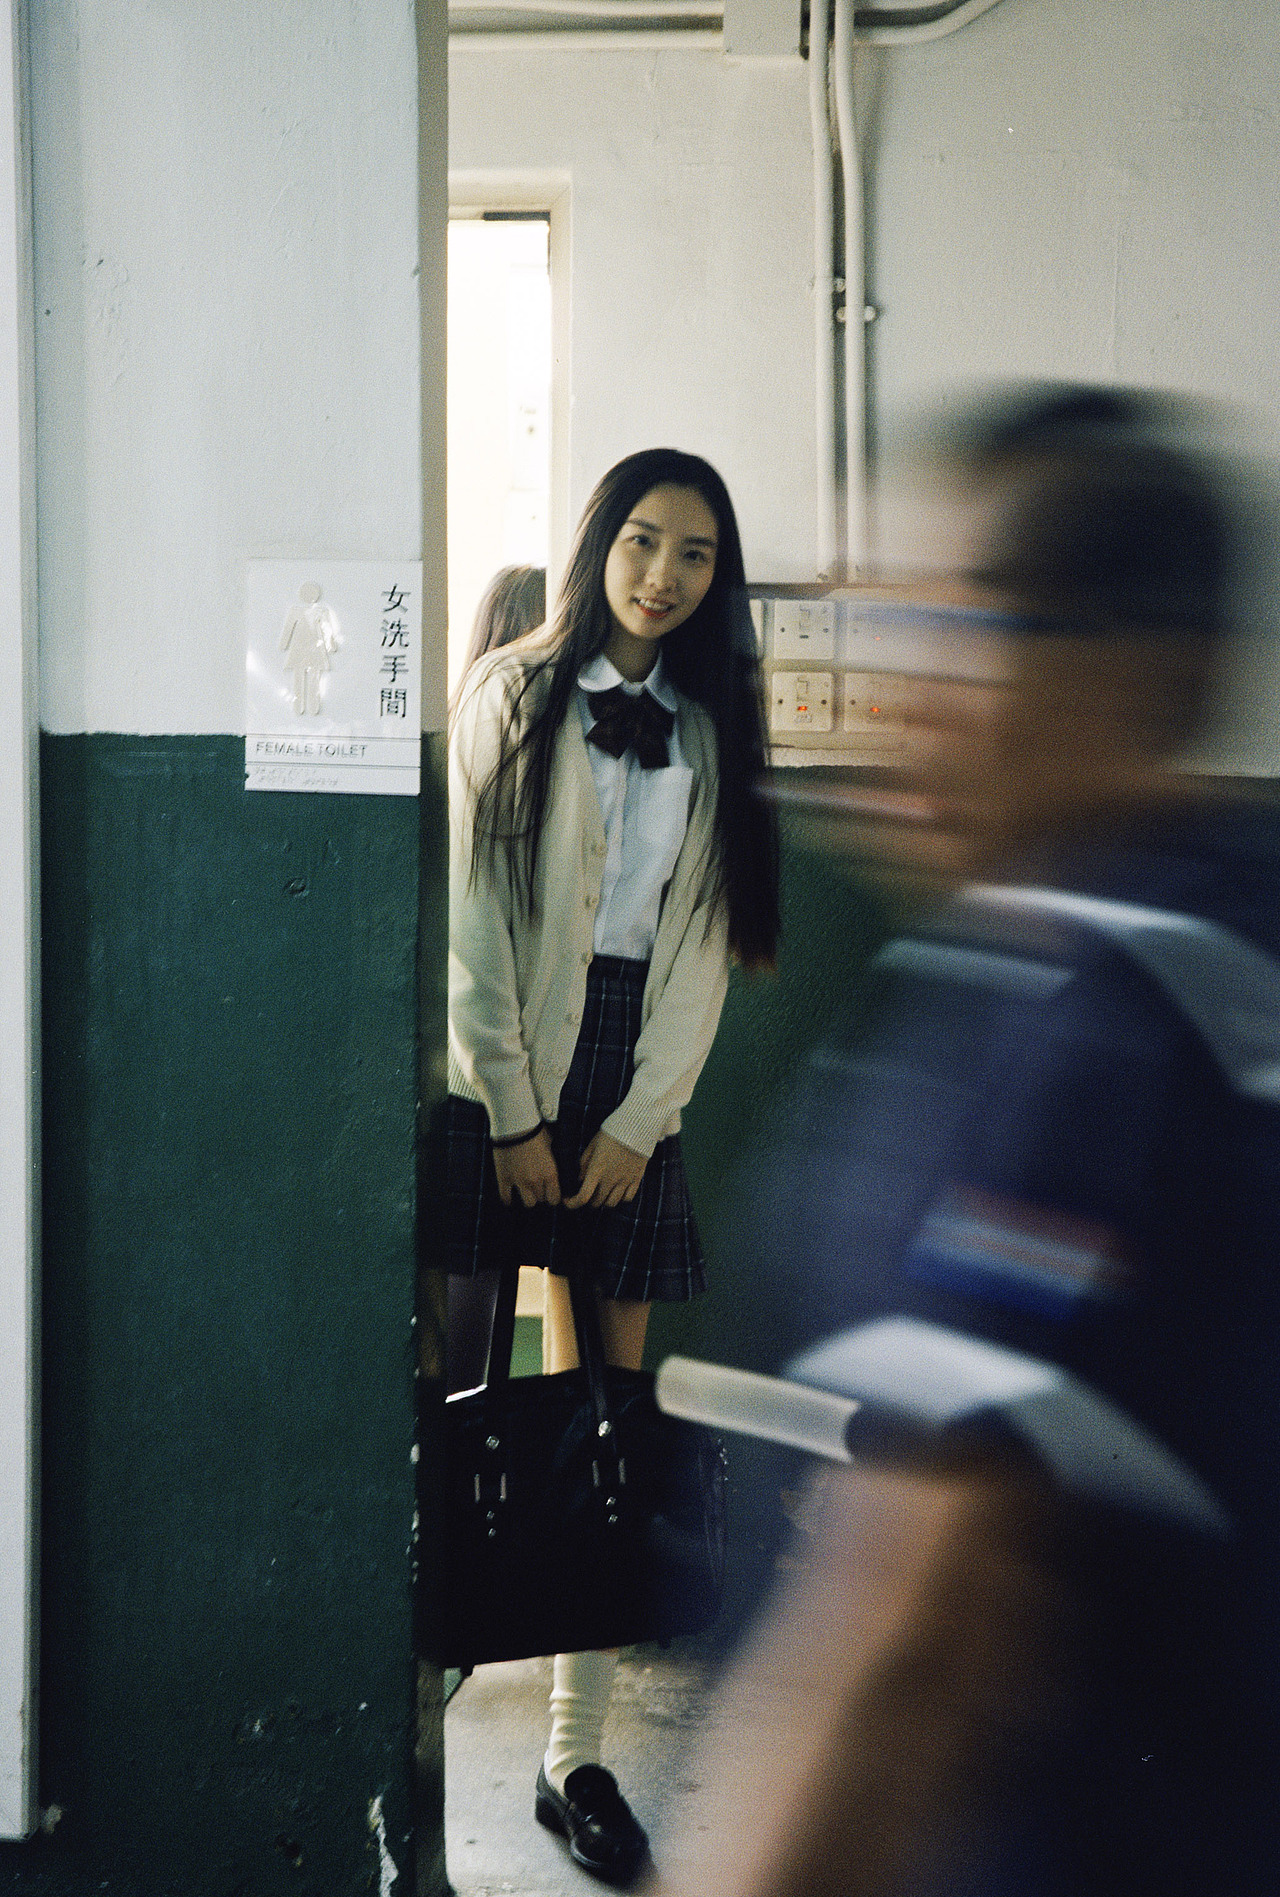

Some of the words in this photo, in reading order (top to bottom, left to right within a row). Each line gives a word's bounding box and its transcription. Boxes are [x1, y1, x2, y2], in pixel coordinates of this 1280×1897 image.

[380, 583, 411, 718] 女洗手間
[255, 741, 314, 757] FEMALE
[316, 743, 368, 758] TOILET
